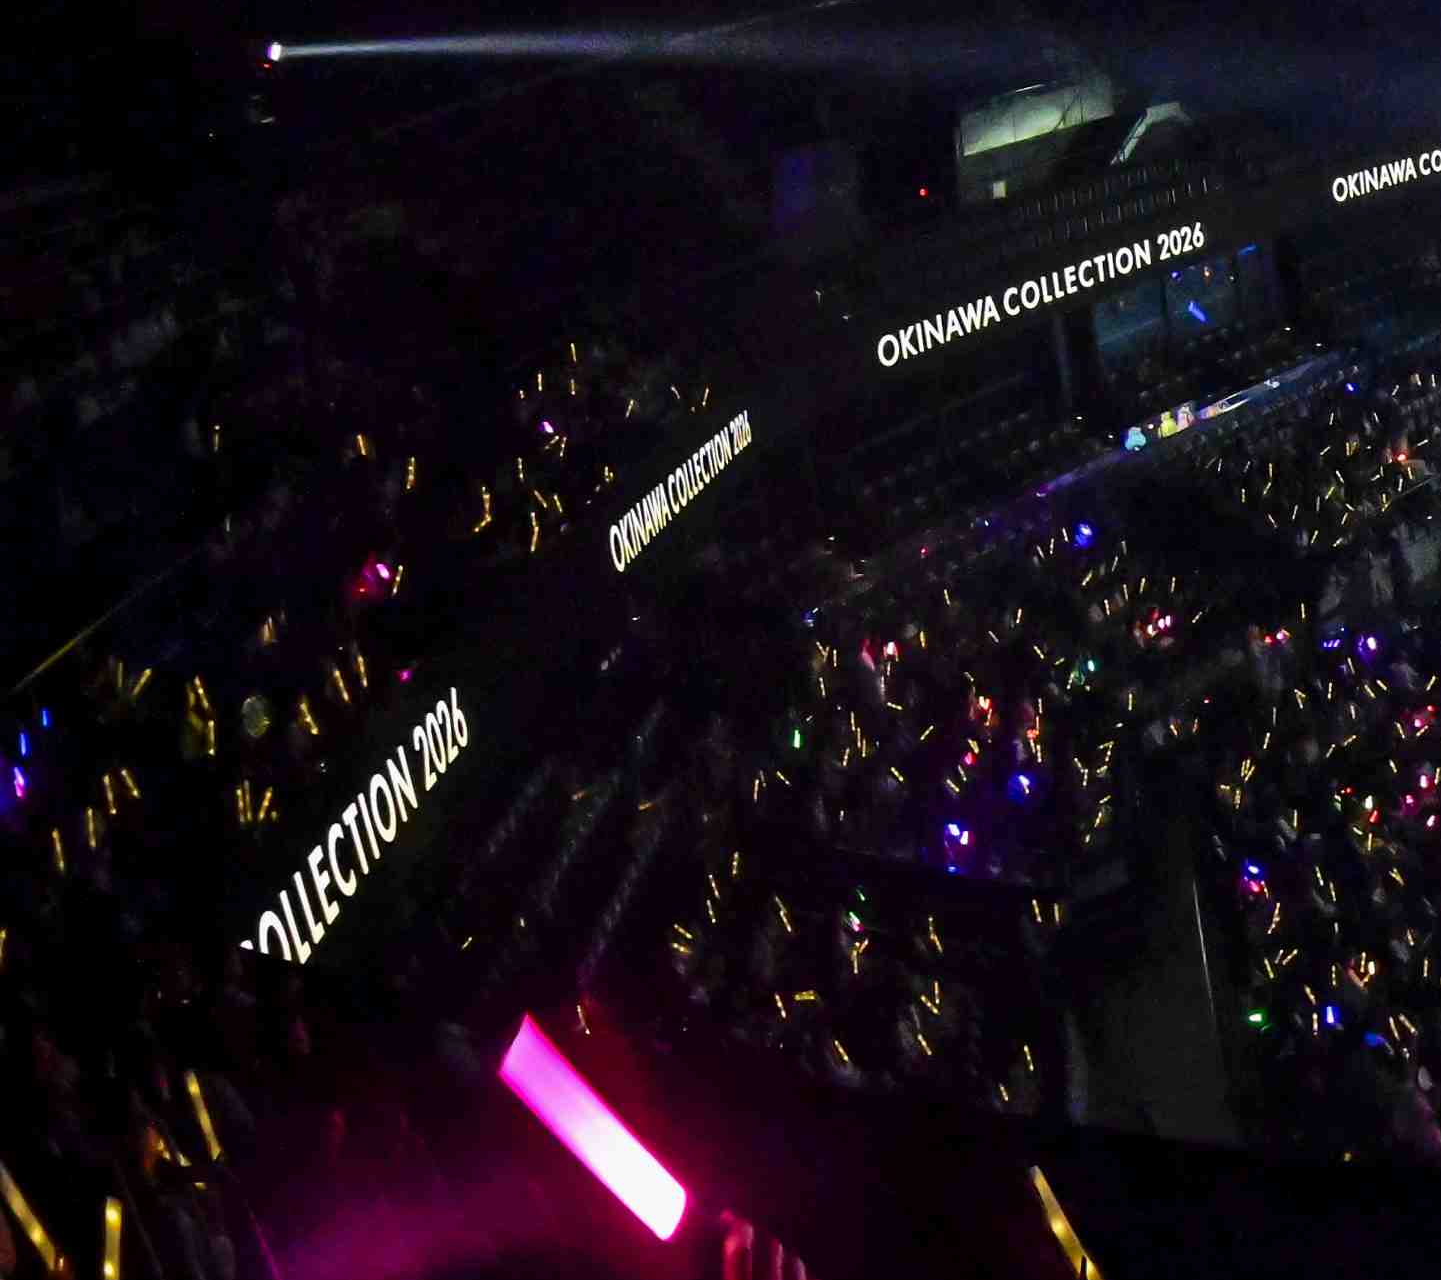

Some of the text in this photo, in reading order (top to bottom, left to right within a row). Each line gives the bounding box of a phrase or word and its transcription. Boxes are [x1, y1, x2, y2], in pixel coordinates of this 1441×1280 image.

[1332, 157, 1418, 202] OKINAWA
[877, 221, 1205, 367] OKINAWA COLLECTION 2026
[609, 409, 752, 573] OKINAWA COLLECTION 2026
[239, 686, 468, 965] OLLECTION 2026
